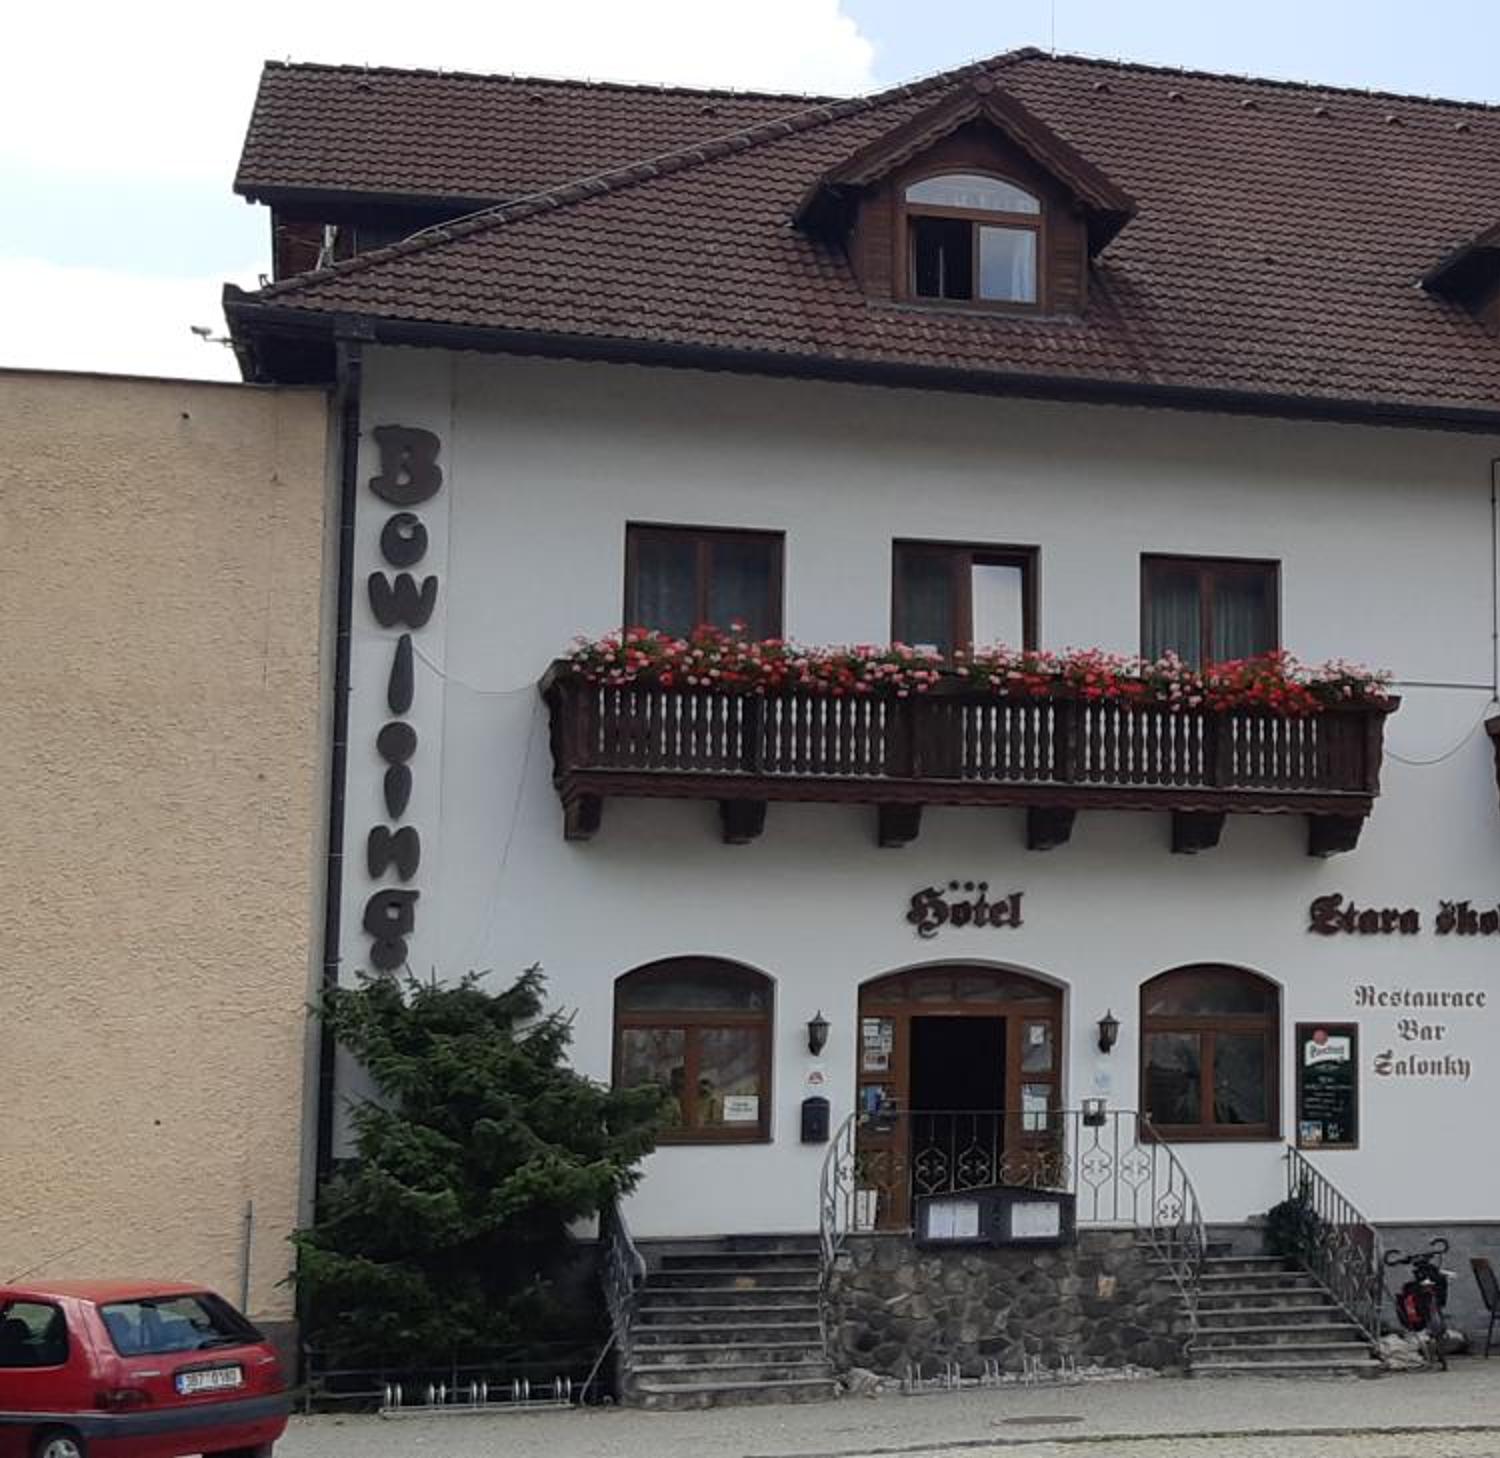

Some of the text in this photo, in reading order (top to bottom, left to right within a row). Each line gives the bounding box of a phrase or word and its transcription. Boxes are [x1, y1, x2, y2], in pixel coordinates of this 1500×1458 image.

[363, 425, 443, 969] Bowling
[907, 887, 1023, 938] Hotel
[1354, 985, 1487, 1007] Restaurace
[1397, 1018, 1446, 1041] Bar
[1374, 1049, 1471, 1080] Salonky
